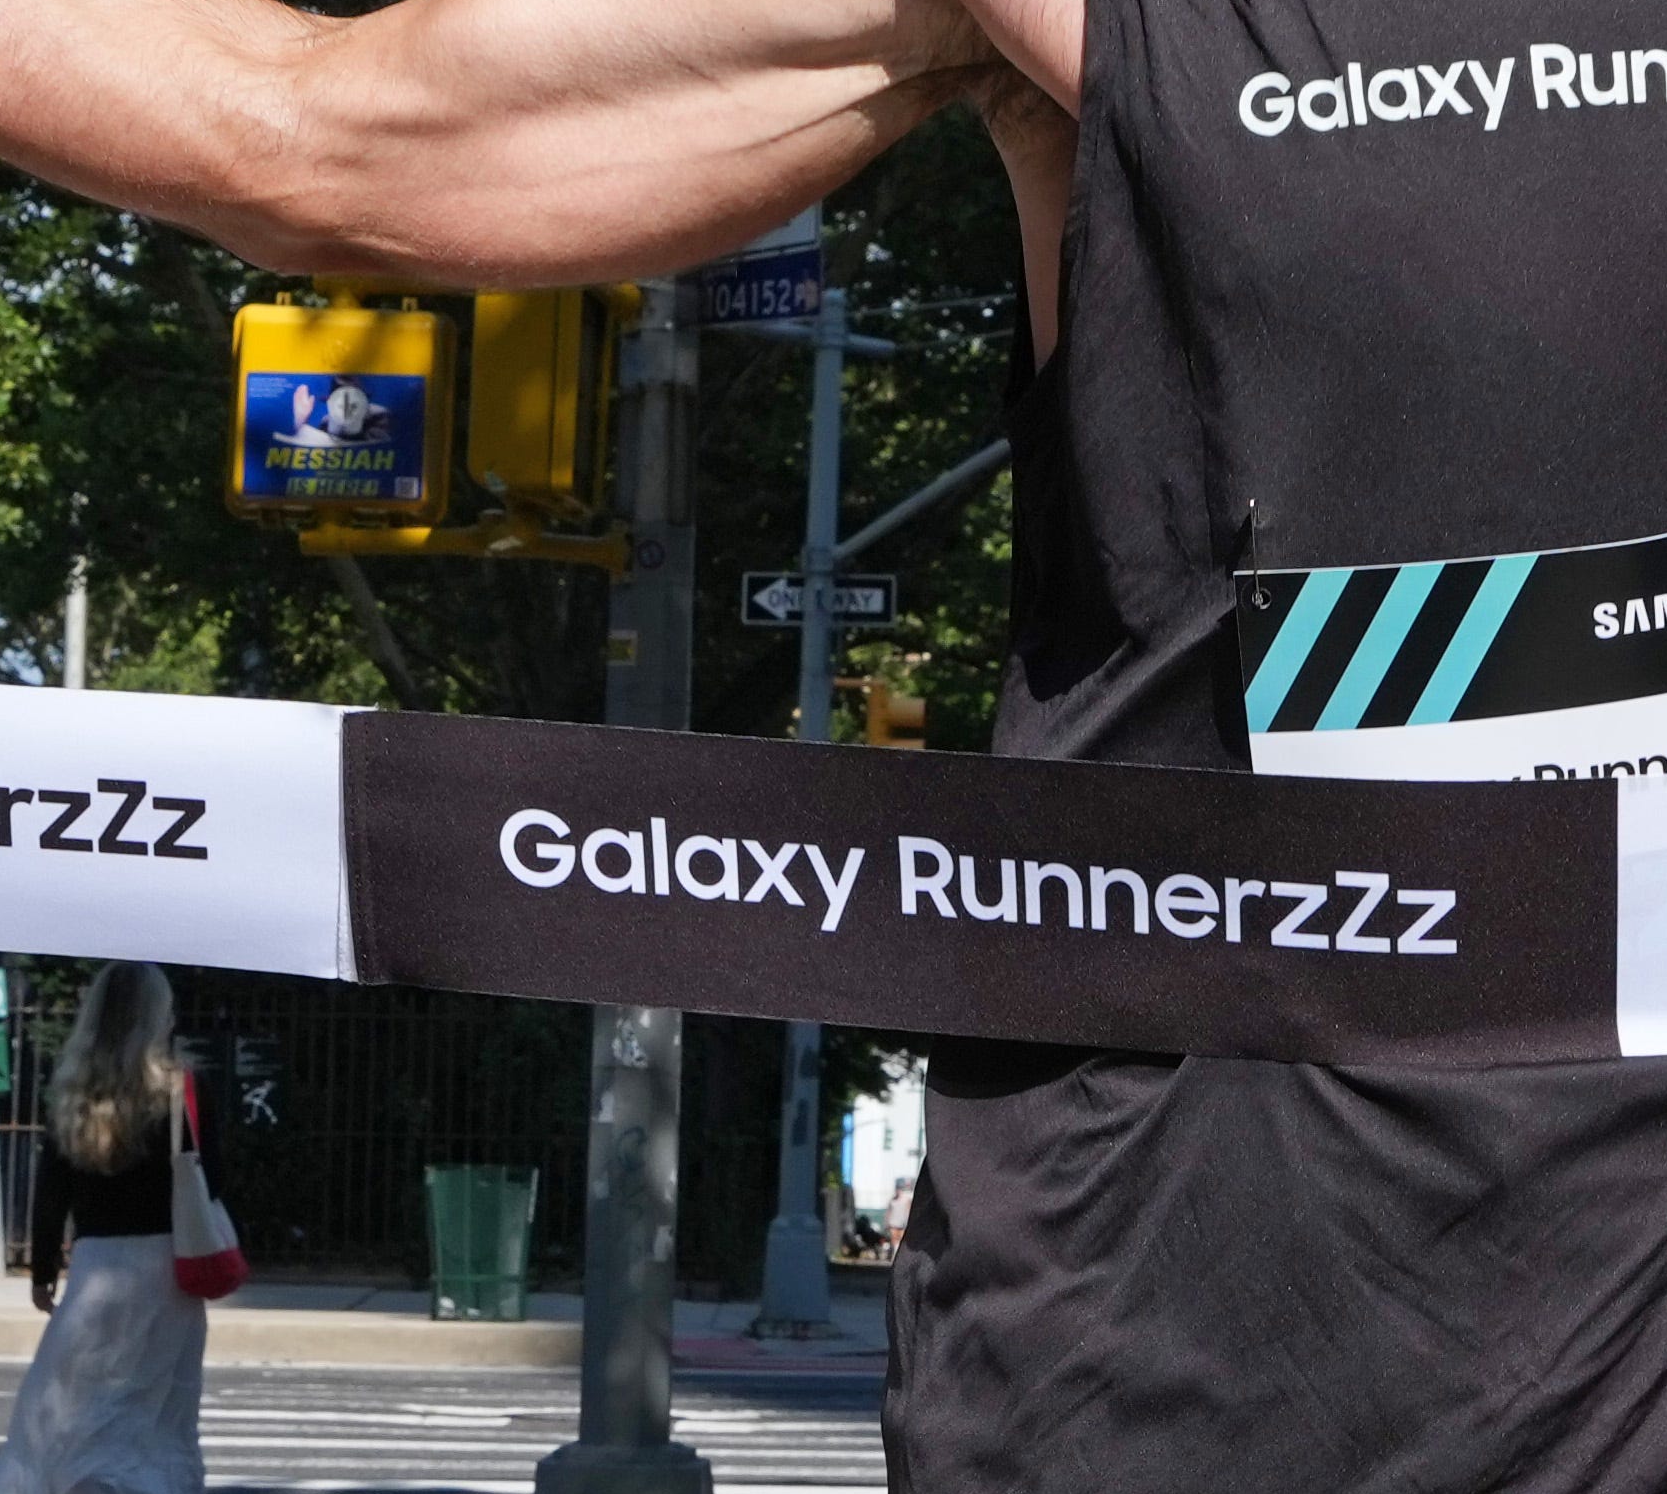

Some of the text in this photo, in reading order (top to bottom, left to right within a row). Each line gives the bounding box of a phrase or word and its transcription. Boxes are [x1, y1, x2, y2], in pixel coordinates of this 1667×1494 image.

[1238, 57, 1516, 137] Galaxy
[264, 446, 396, 471] MESSIAH
[499, 808, 1458, 954] Galaxy RunnerzZz
